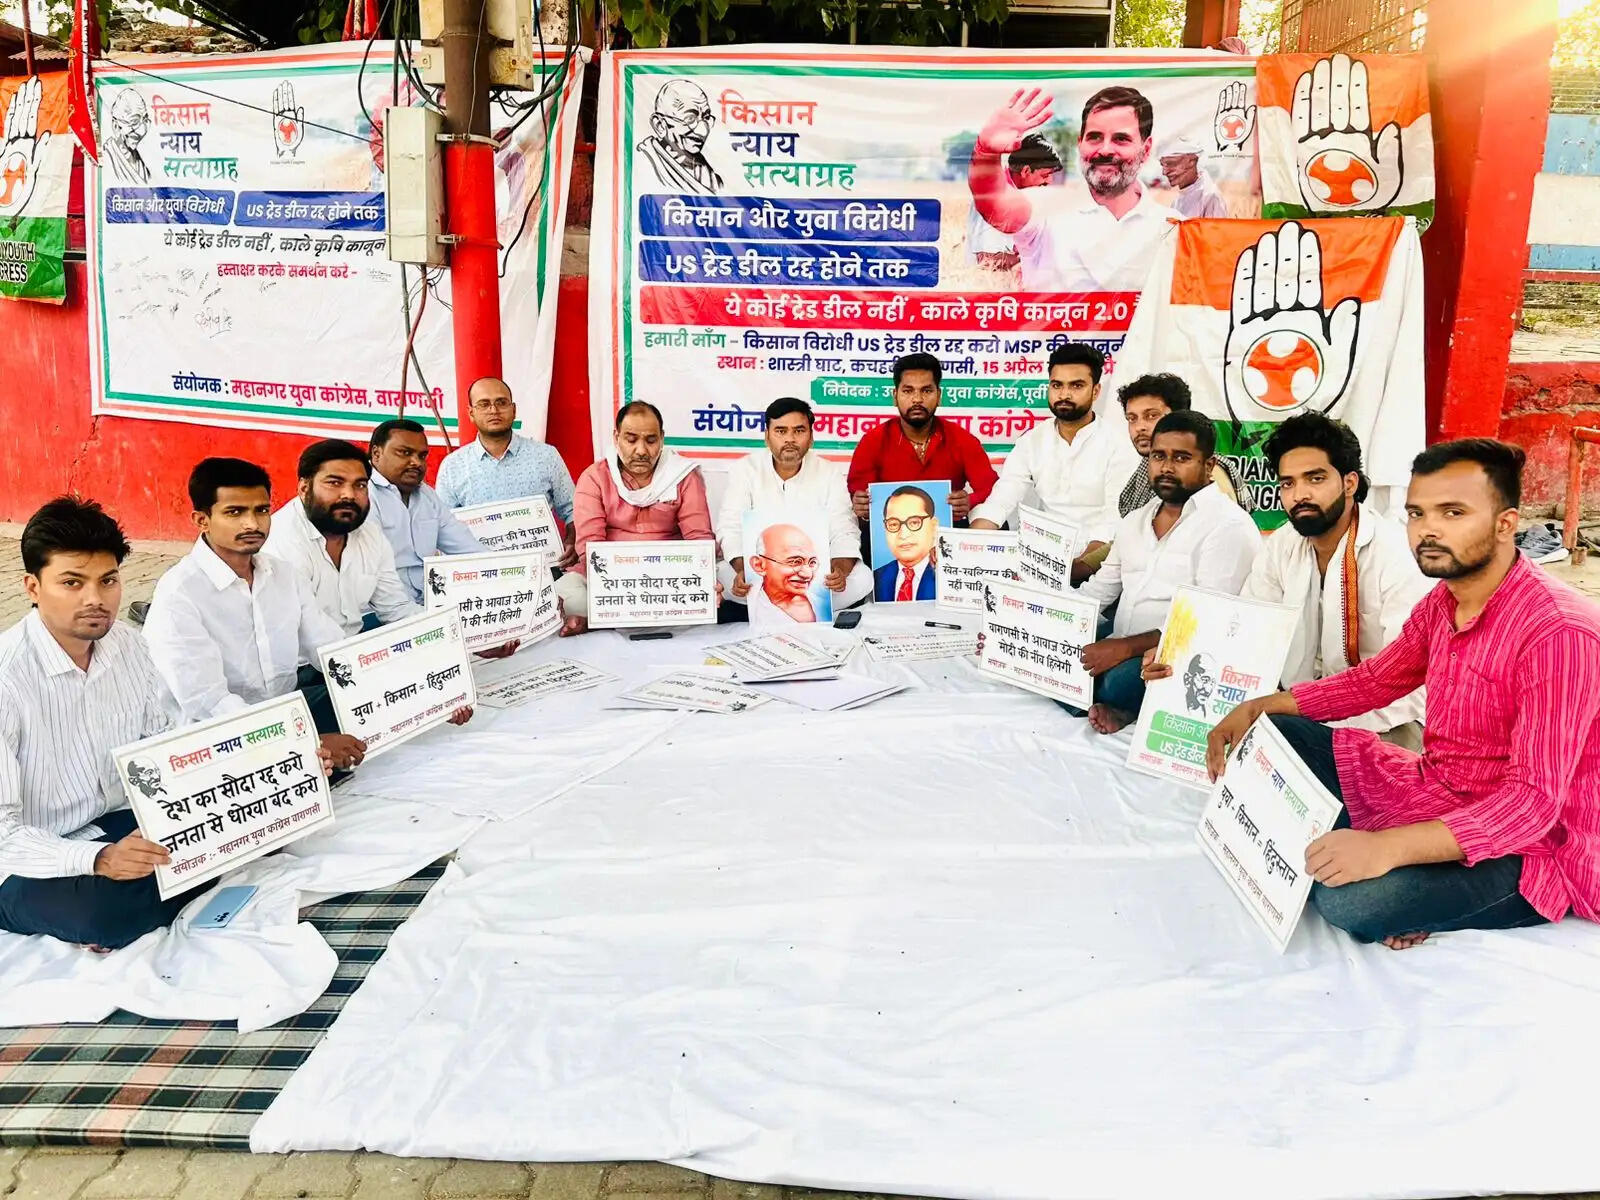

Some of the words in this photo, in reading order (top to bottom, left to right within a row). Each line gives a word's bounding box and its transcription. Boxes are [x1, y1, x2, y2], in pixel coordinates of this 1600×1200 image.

[152, 95, 211, 126] किसान
[718, 89, 818, 126] किसान
[160, 132, 202, 153] न्याय
[729, 132, 800, 158] न्याय
[164, 158, 238, 182] सत्याग्रह
[741, 162, 857, 190] सत्याग्रह
[113, 196, 144, 213] किसान
[146, 196, 165, 213] और
[166, 199, 185, 218] युवा
[186, 194, 225, 215] विरोधी
[247, 205, 264, 219] US
[266, 201, 283, 220] ट्रेड
[284, 201, 308, 219] डील
[309, 205, 325, 222] रद्द
[327, 202, 351, 223] होने
[353, 204, 379, 220] तक
[663, 199, 743, 229] किसान
[749, 201, 789, 230] और
[793, 207, 837, 236] युवा
[842, 202, 916, 232] विरोधी
[164, 228, 173, 246] ये
[174, 230, 196, 248] कोई
[198, 228, 214, 250] ट्रेड
[216, 231, 240, 249] डील
[280, 234, 310, 252] काले
[314, 235, 348, 256] कृषि
[346, 238, 386, 256] कानून
[217, 263, 255, 277] हस्ताक्षर
[257, 263, 285, 278] करके
[288, 262, 327, 278] समर्थन
[666, 255, 696, 274] US
[701, 249, 734, 277] ट्रेड
[737, 249, 781, 277] डील
[785, 256, 815, 280] रद्द
[819, 252, 865, 281] होने
[867, 258, 910, 278] तक
[725, 293, 742, 316] ये
[746, 293, 790, 319] कोई
[791, 294, 818, 321] ट्रेड
[822, 295, 862, 319] डील
[921, 295, 970, 321] काले
[974, 297, 1019, 327] कृषि
[1023, 302, 1089, 328] कानून
[1094, 302, 1128, 321] 2.0
[643, 328, 689, 348] हमारी
[743, 332, 799, 350] किसान
[802, 332, 854, 351] विरोधी
[858, 338, 880, 351] US
[884, 333, 906, 353] ट्रेड
[909, 333, 941, 352] डील
[944, 339, 965, 354] रद्द
[967, 334, 1000, 354] करो
[1005, 339, 1041, 354] MSP
[717, 354, 757, 370] स्थान
[768, 354, 811, 372] शास्त्री
[816, 358, 846, 374] घाट,
[983, 361, 999, 374] 15
[1003, 356, 1044, 375] अप्रैल
[172, 372, 221, 394] संयोजक
[230, 379, 286, 399] महानगर
[290, 384, 316, 406] युवा
[319, 384, 372, 408] कांग्रेस,
[822, 377, 871, 397] निवेदक
[946, 387, 972, 403] युवा
[692, 404, 766, 433] संयोज
[453, 571, 478, 582] किसान
[480, 568, 498, 578] न्याय
[500, 566, 527, 576] सत्याग्रह
[601, 576, 618, 590] देश
[621, 579, 636, 589] का
[638, 574, 663, 588] सौदा
[666, 578, 680, 589] रद्द
[681, 574, 702, 586] करो
[474, 596, 482, 610] से
[485, 595, 512, 608] आवाज
[513, 590, 533, 604] उठेगी
[595, 595, 624, 606] जनता
[626, 592, 637, 605] से
[671, 591, 686, 605] बंद
[689, 590, 709, 602] करो
[1003, 595, 1024, 611] किसान
[1027, 602, 1043, 615] न्याय
[1046, 607, 1074, 624] सत्याग्रह
[470, 616, 481, 627] की
[500, 608, 522, 623] हिलेगी
[358, 649, 389, 668] किसान
[391, 639, 412, 653] न्याय
[413, 627, 445, 645] सत्याग्रह
[988, 622, 1020, 640] वाराणसी
[1021, 628, 1029, 643] से
[1032, 635, 1058, 652] आवाज
[1060, 640, 1083, 660] उठेगी
[998, 639, 1016, 656] मोदी
[1018, 646, 1028, 660] की
[1046, 655, 1072, 674] हिलेगी
[1221, 665, 1261, 690] किसान
[352, 701, 374, 725] युवा
[384, 684, 417, 706] किसान
[426, 664, 461, 690] हिंदुस्तान
[1217, 685, 1247, 702] न्याय
[1164, 714, 1195, 736] किसान
[169, 747, 212, 772] किसान
[213, 736, 243, 754] न्याय
[244, 721, 286, 745] सत्याग्रह
[1160, 740, 1174, 754] US
[157, 797, 191, 821] देश
[192, 787, 217, 808] का
[217, 773, 256, 800] सौदा
[256, 765, 279, 786] रद्द
[276, 751, 304, 775] करो
[1272, 768, 1286, 792] न्याय
[159, 822, 206, 854] जनता
[206, 812, 224, 834] से
[228, 797, 268, 825] धोखा
[269, 787, 293, 807] बंद
[292, 774, 319, 798] करो
[171, 852, 206, 875] संयोजक
[217, 834, 250, 855] महानगर
[251, 827, 266, 845] युवा
[267, 814, 291, 833] कांग्रेस
[292, 802, 321, 823] वाराणसी
[1218, 784, 1234, 808] युवा
[1235, 803, 1259, 843] किसान
[1263, 838, 1298, 888] हिंदुस्तान
